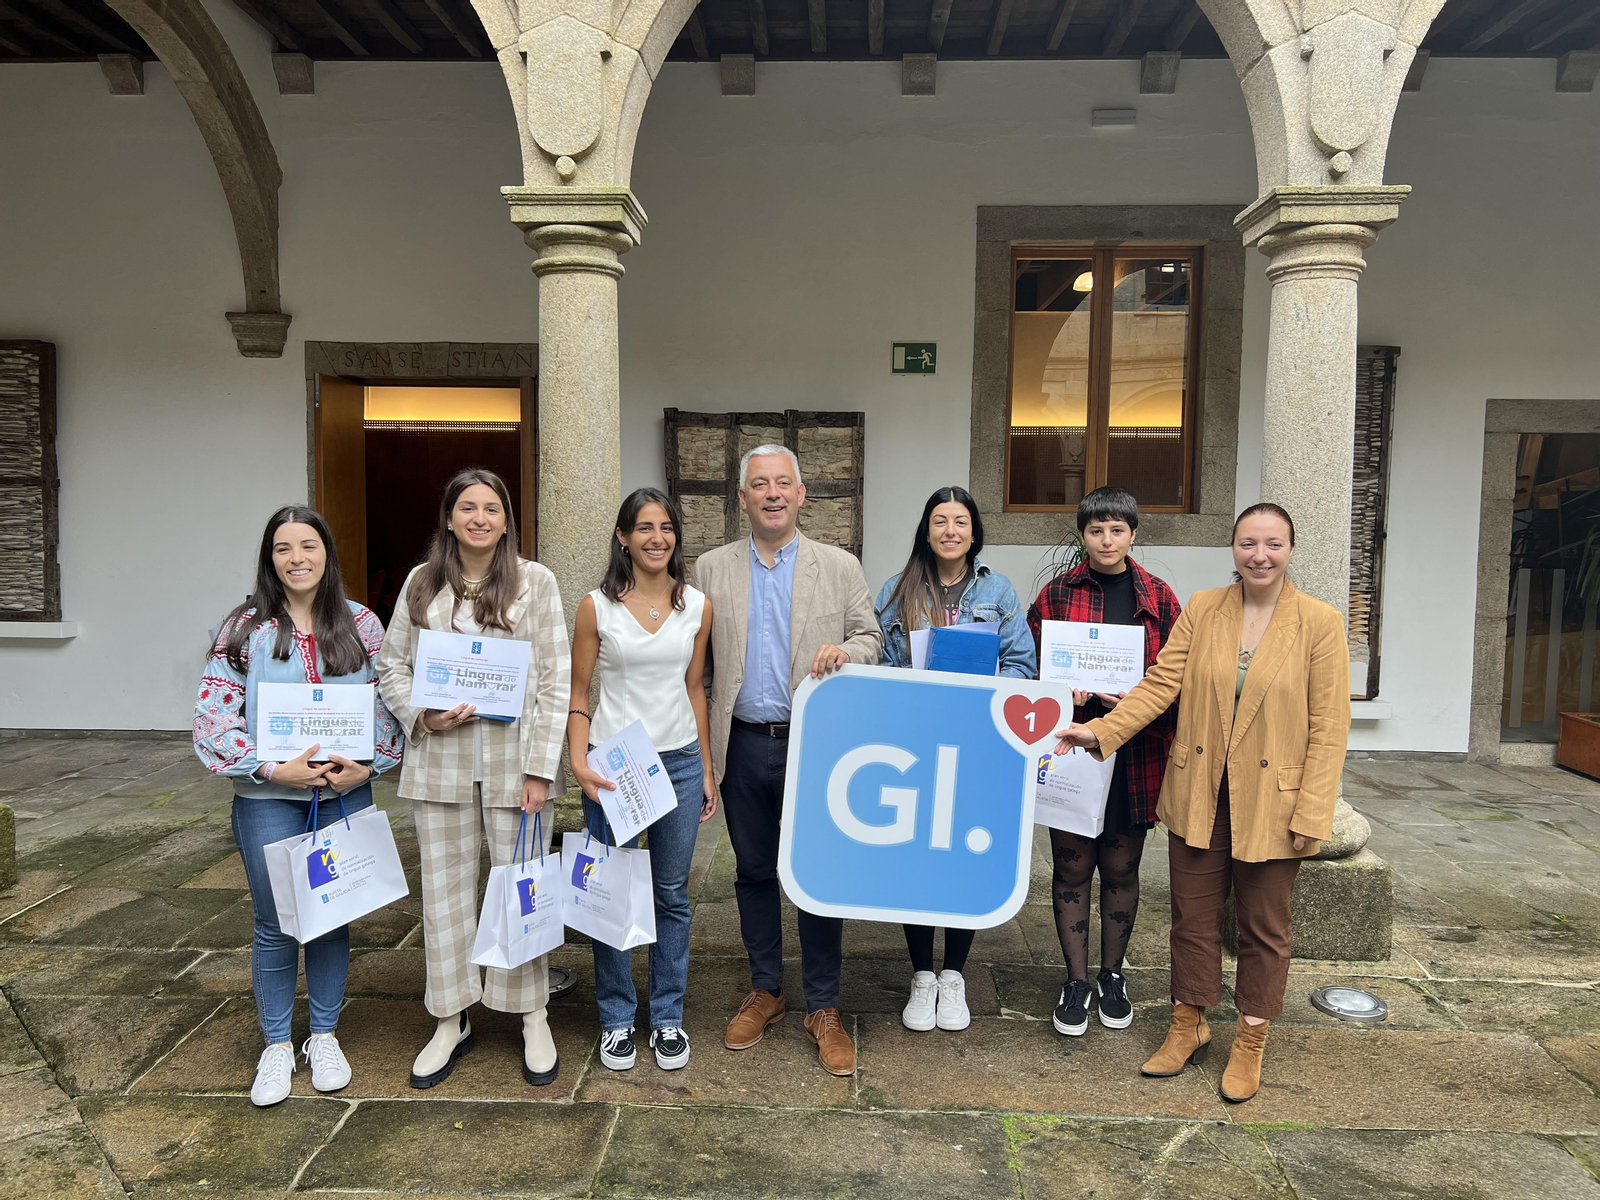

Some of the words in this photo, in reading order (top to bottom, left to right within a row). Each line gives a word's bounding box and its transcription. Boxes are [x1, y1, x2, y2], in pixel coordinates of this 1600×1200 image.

[1078, 652, 1120, 664] Lingua
[456, 668, 502, 681] Lingua
[504, 675, 516, 683] de
[300, 717, 348, 728] Lingua
[1024, 711, 1037, 733] 1
[623, 769, 644, 811] Lingua
